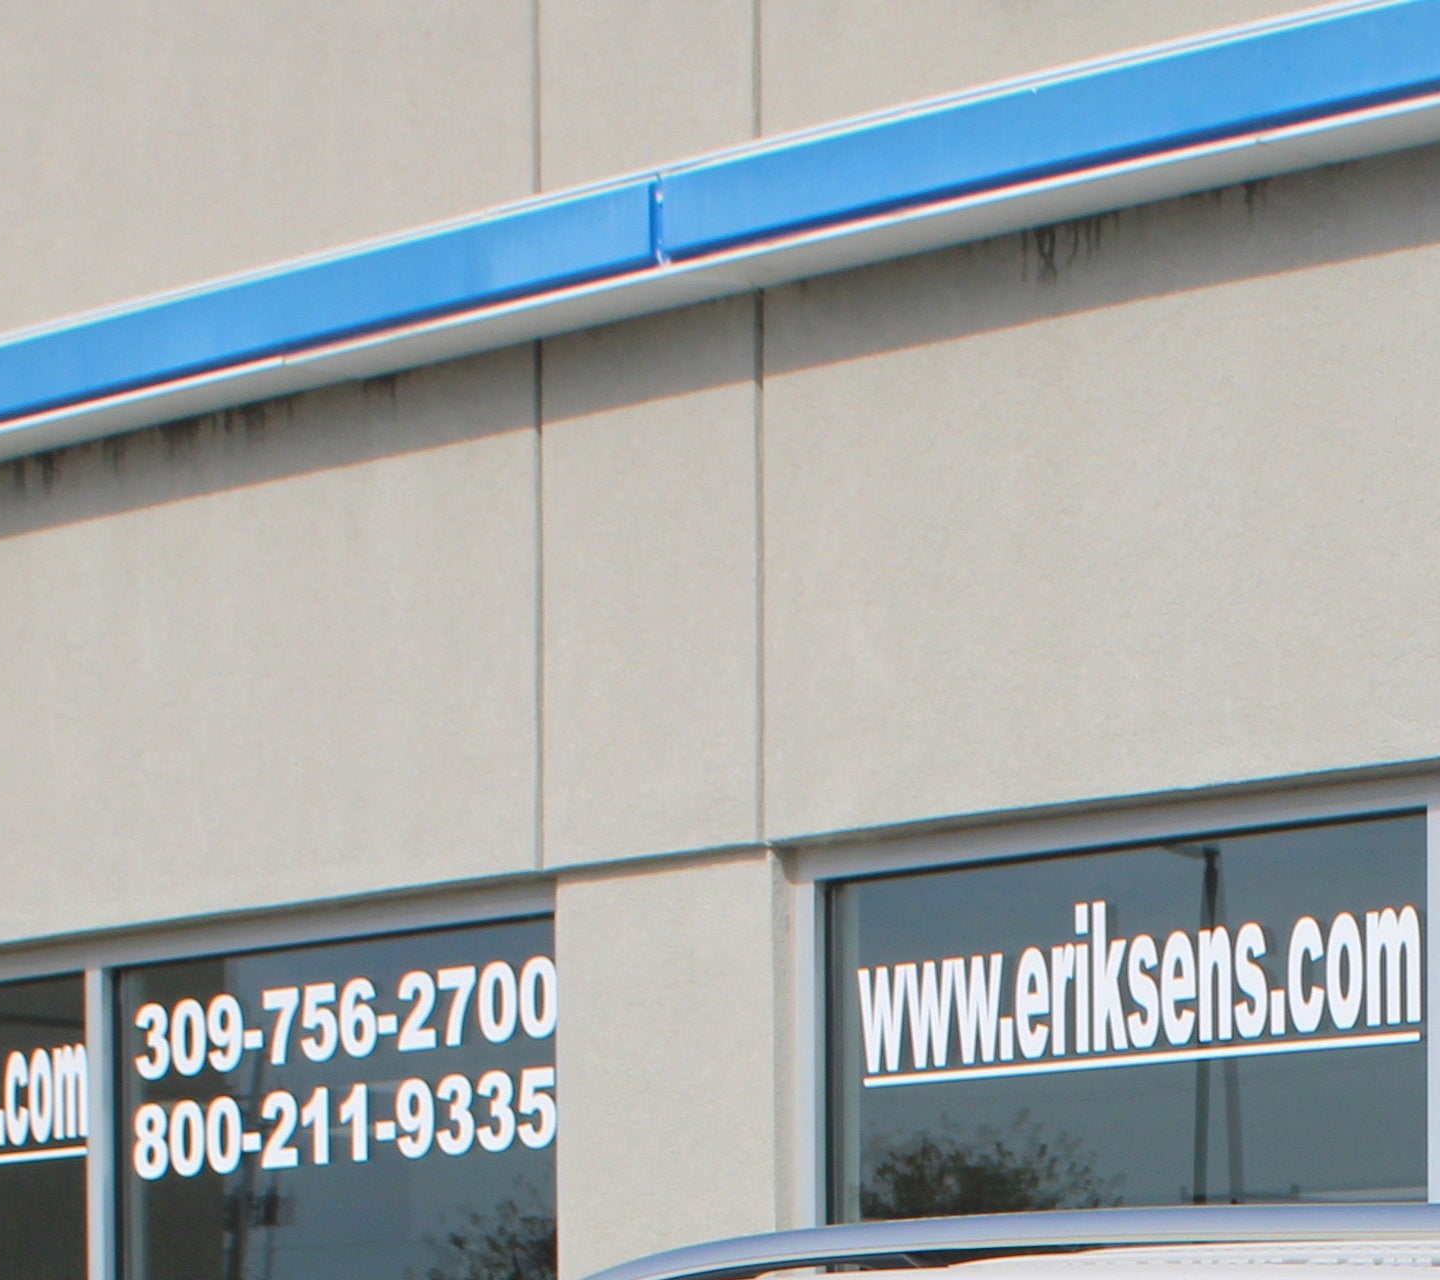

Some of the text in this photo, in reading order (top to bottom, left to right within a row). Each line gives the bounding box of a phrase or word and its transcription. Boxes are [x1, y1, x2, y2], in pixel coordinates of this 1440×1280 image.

[134, 955, 558, 1081] 309-756-2700
[858, 899, 1420, 1074] www.eriksens.com
[133, 1066, 557, 1181] 800-211-9335
